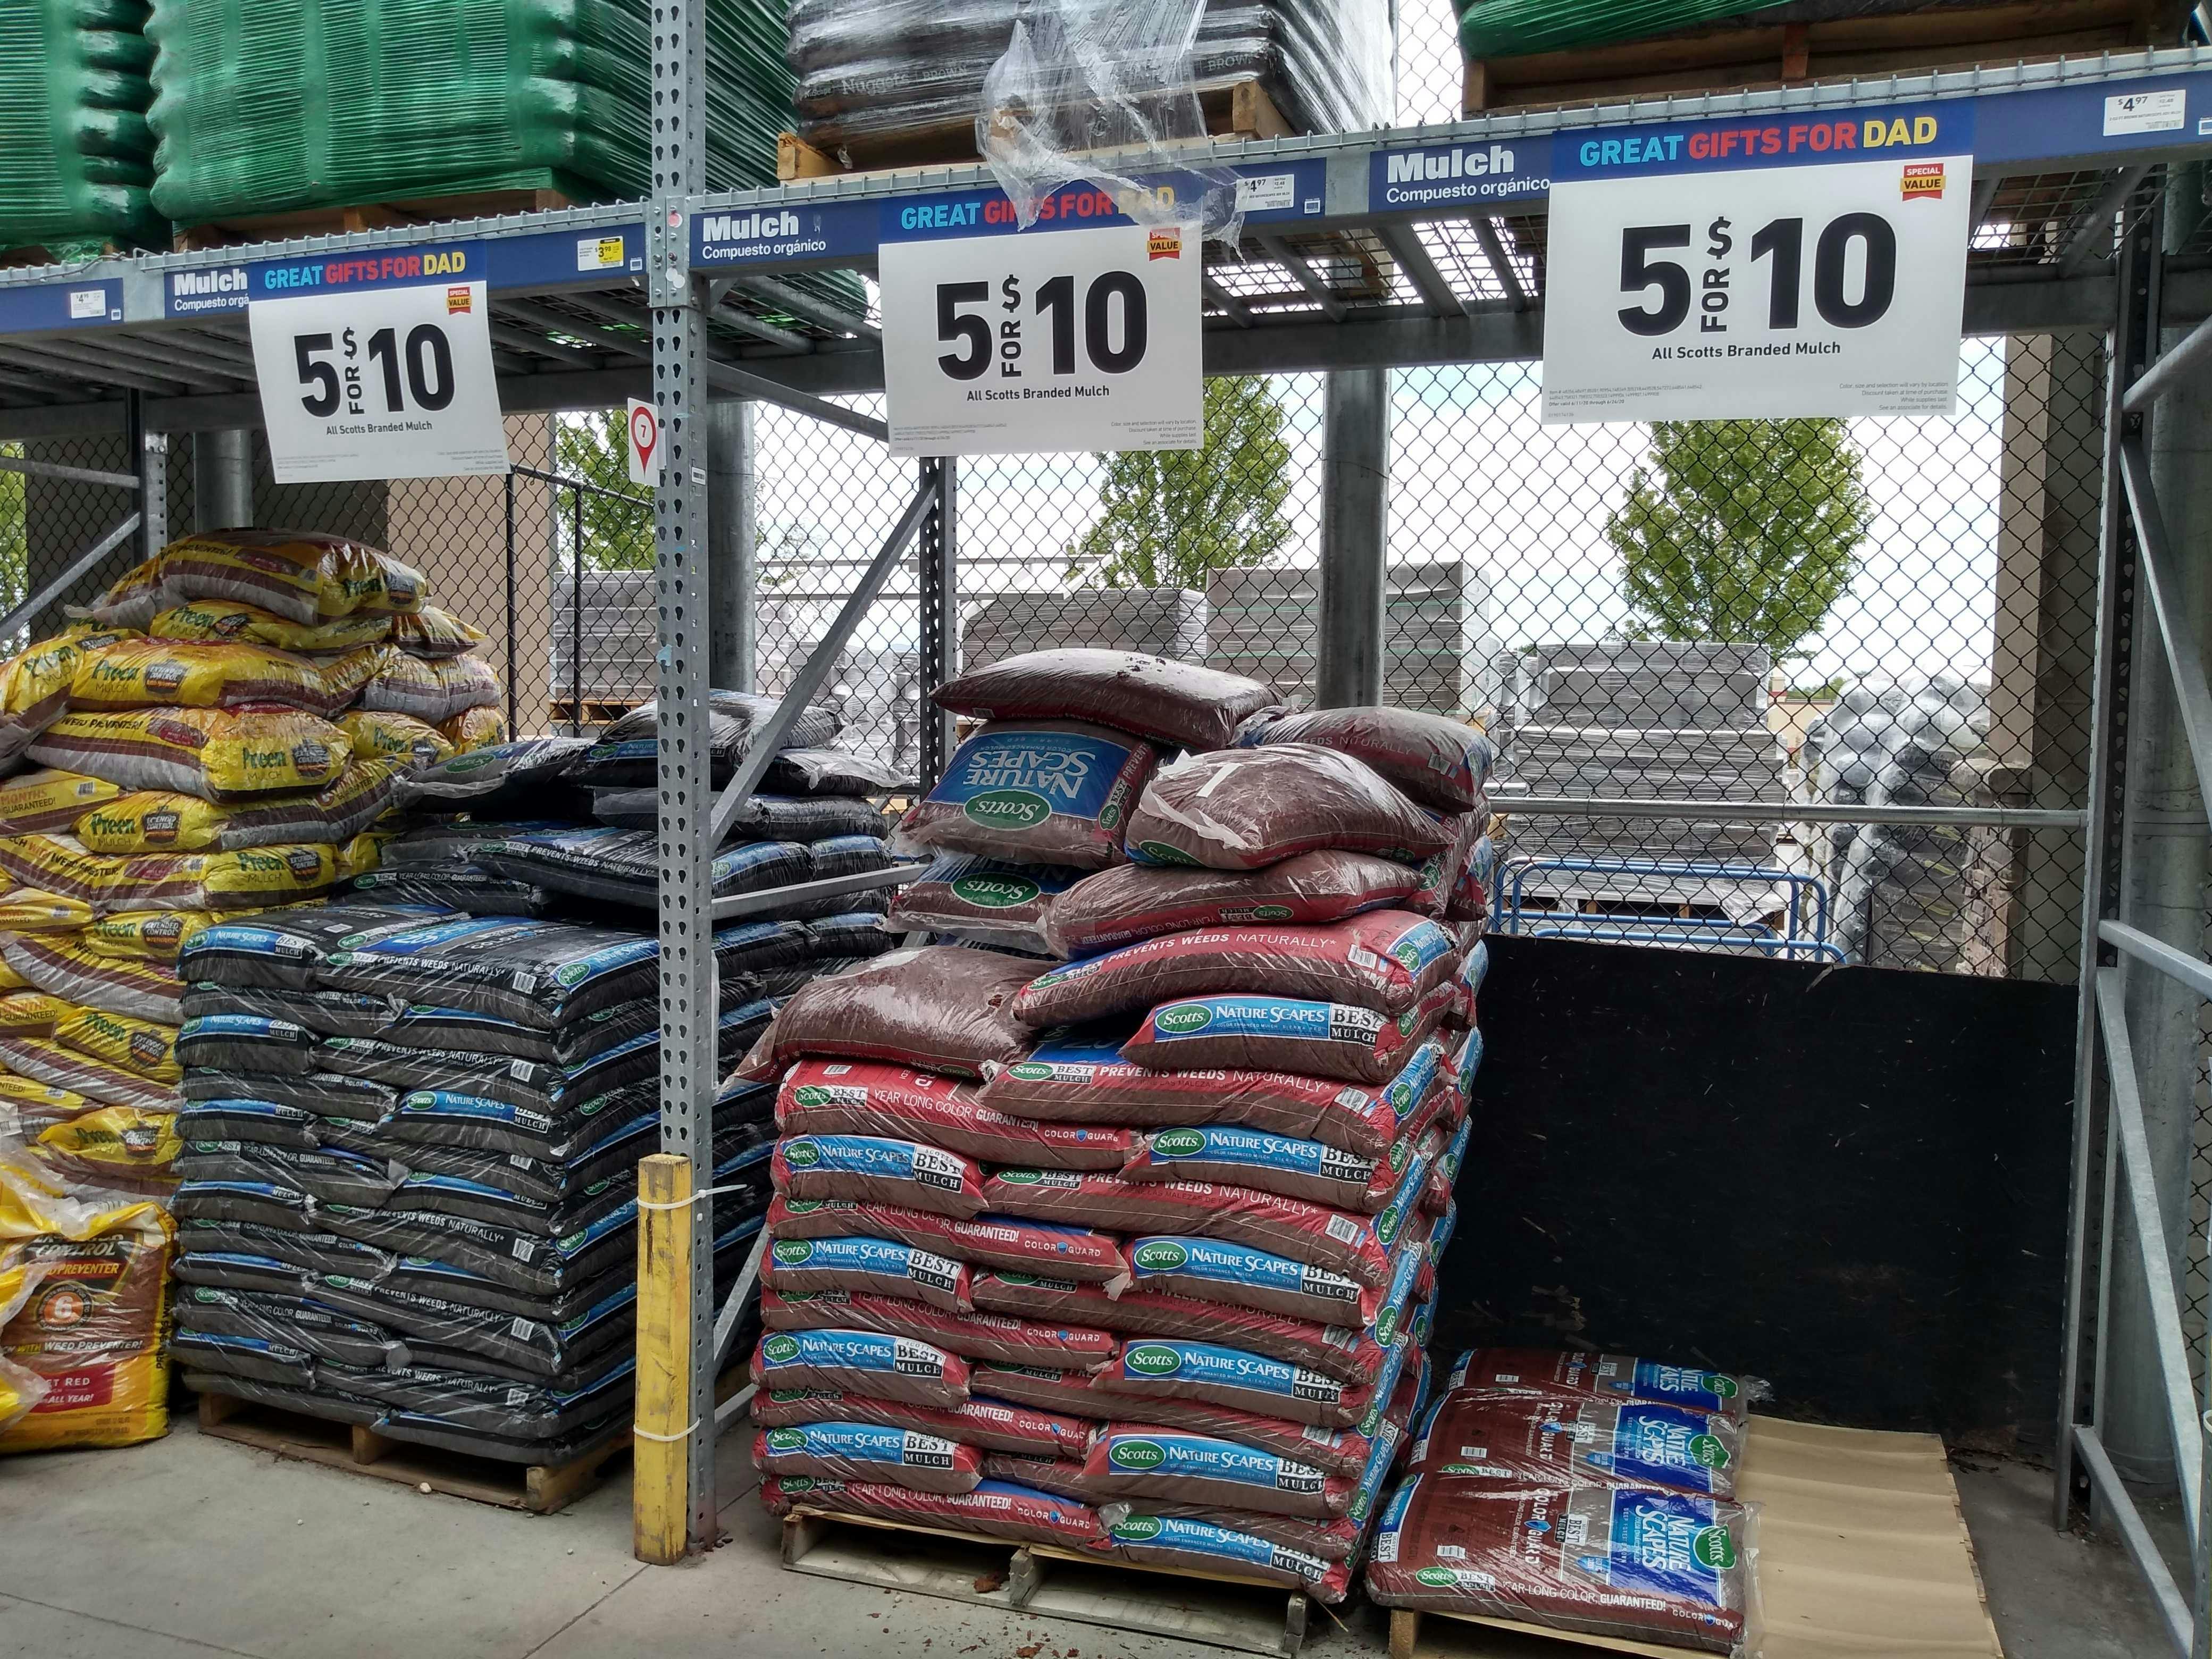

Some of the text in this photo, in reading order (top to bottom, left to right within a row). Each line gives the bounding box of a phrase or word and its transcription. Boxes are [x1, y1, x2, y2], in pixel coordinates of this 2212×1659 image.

[1580, 116, 1938, 166] GREAT GIFTS FOR DAD
[1387, 145, 1514, 183] Mulch
[1906, 167, 1941, 175] SPECIAL
[1386, 177, 1551, 204] Compuesto orgánico
[1904, 179, 1941, 189] VALUE
[901, 202, 980, 229] GREAT
[1061, 191, 1113, 219] FOR
[702, 212, 799, 242] Mulch
[702, 239, 826, 260] Compuesto orgánico
[1151, 241, 1178, 250] VALUE
[265, 252, 466, 289] GREAT GIFTS FOR DAD
[1618, 224, 1691, 336] 5
[1701, 267, 1730, 332] FOR
[174, 269, 248, 296] Mulch
[174, 293, 249, 312] Compuesto orgá
[936, 281, 992, 381] 5
[1001, 320, 1022, 378] FOR
[1652, 341, 1841, 359] All Scotts Branded Mulch
[294, 332, 341, 418] 5
[345, 366, 365, 415] FOR
[967, 386, 1110, 401] All Scotts Branded Mulch
[326, 421, 433, 435] All Scotts Branded Mulch
[641, 424, 646, 438] 7
[242, 748, 287, 769] Preen
[969, 750, 1095, 776] SCAPES
[963, 769, 1086, 798] NATURE
[975, 800, 1041, 821] Scotts
[91, 813, 136, 835] Preen
[963, 879, 1031, 899] Scotts
[1108, 939, 1174, 963] PREVENTS
[1182, 934, 1229, 946] WEEDS
[1163, 1011, 1205, 1025] Scotts
[1331, 1027, 1377, 1043] MULCH
[1013, 1065, 1226, 1080] Scotts BEST PREVENTS WEEDS
[515, 1116, 546, 1129] MULCH
[833, 1088, 1075, 1139] BEST YEAR LONG COLOR, COLOR
[1157, 1135, 1199, 1148] Scotts
[914, 1171, 959, 1188] MULCH
[1002, 1170, 1212, 1194] Scotts BEST WEEDS
[1322, 1165, 1371, 1180] MULCH
[1042, 1179, 1077, 1188] MULCH
[419, 1212, 446, 1226] WEEDS
[954, 1221, 1101, 1256] GUARANTEED! COLOR GUARD
[776, 1244, 959, 1274] Scotts BEST
[1141, 1250, 1180, 1261] Scotts
[908, 1267, 954, 1292] MULCH
[1303, 1282, 1356, 1298] MULCH
[54, 1295, 73, 1318] 6
[1027, 1328, 1057, 1339] COLOR
[1069, 1333, 1101, 1342] GUARD
[895, 1362, 942, 1373] MULCH
[1133, 1354, 1174, 1367] Scotts
[65, 1377, 90, 1386] RED
[1024, 1369, 1059, 1380] MULCH
[68, 1394, 94, 1402] YEAR!
[1019, 1420, 1050, 1432] COLOR
[904, 1453, 950, 1466] MULCH
[1117, 1446, 1158, 1460] Scotts
[947, 1494, 1090, 1529] GUARANTEED! COLOR GUARD
[1116, 1520, 1154, 1532] Scotts
[1635, 1505, 1668, 1574] SCAPES
[1668, 1514, 1691, 1571] NATURE
[1273, 1555, 1323, 1581] MULCH
[1560, 1589, 1704, 1621] COLOR, GUARANTEED! COLOR
